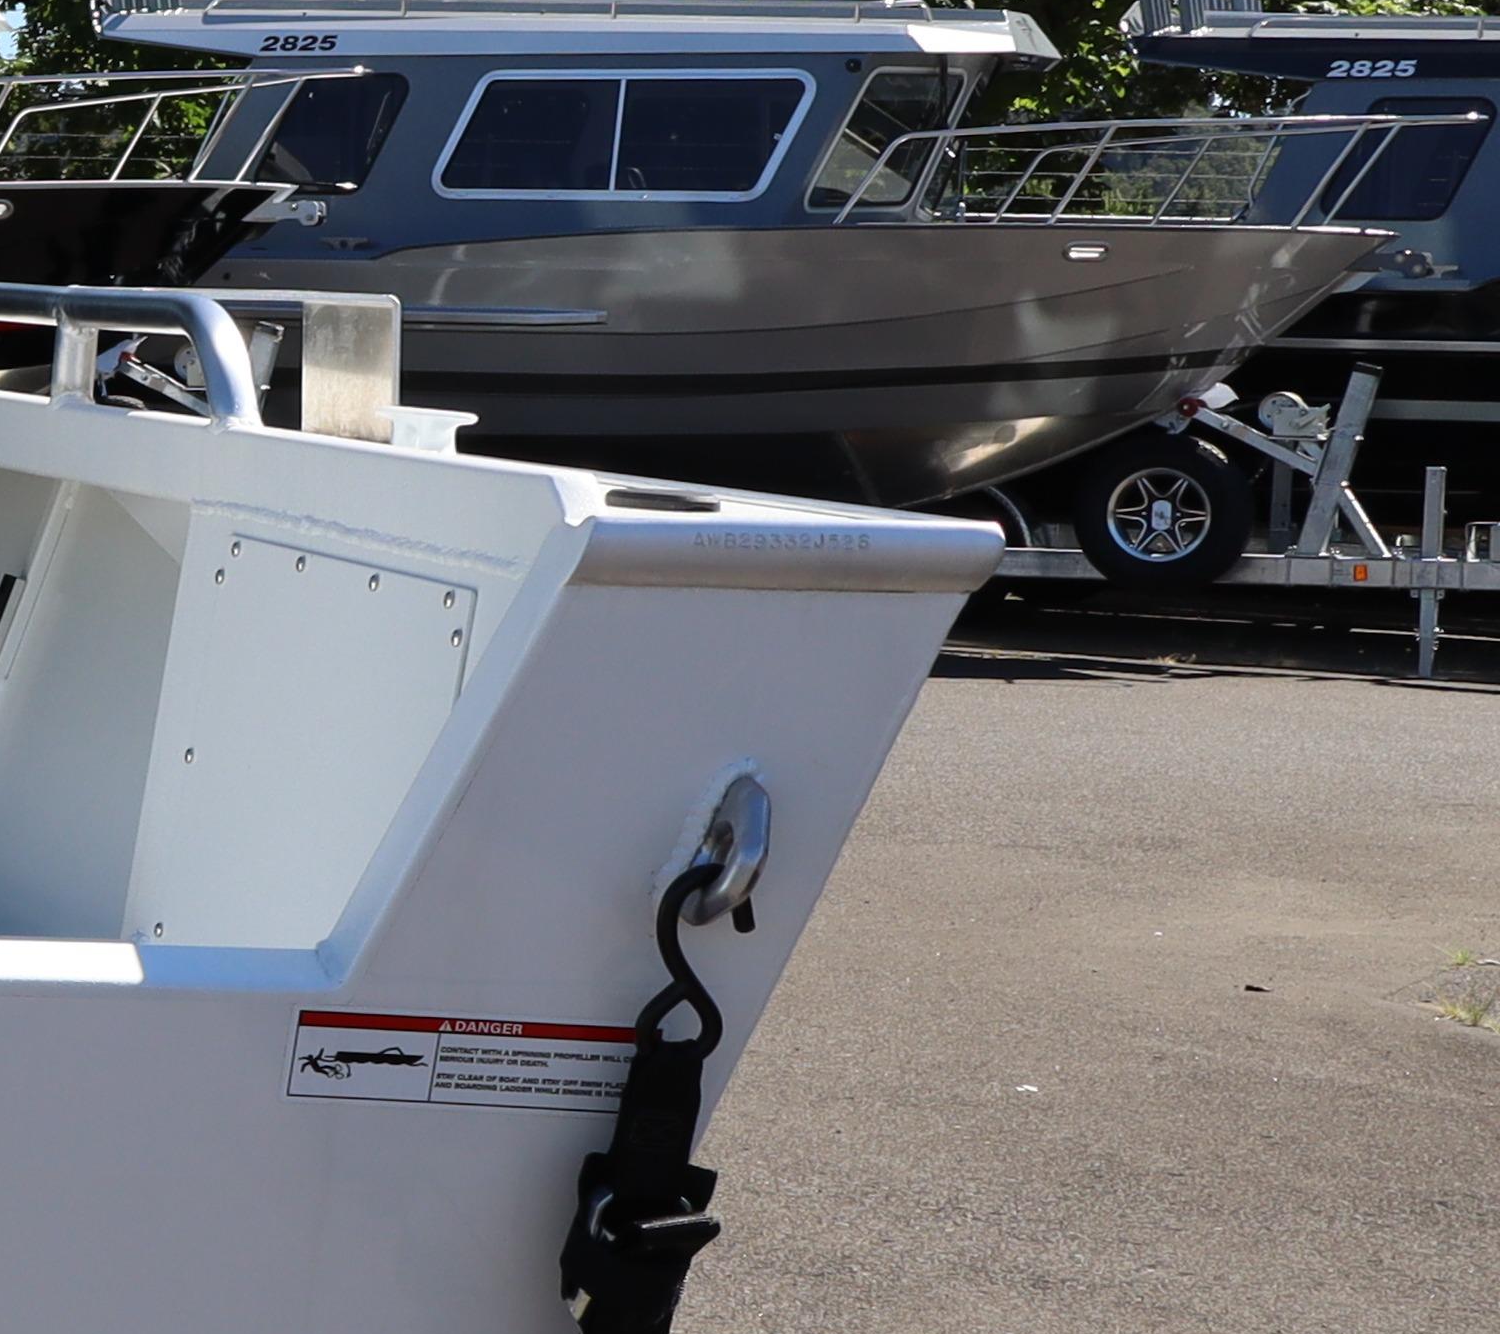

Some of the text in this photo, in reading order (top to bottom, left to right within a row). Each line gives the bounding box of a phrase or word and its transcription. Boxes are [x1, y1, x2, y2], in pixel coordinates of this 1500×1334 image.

[259, 34, 338, 52] 2825
[1325, 59, 1418, 78] 2825
[455, 1020, 524, 1036] DANGER
[440, 1046, 480, 1056] CONTACT
[554, 1052, 601, 1061] PROPELLER
